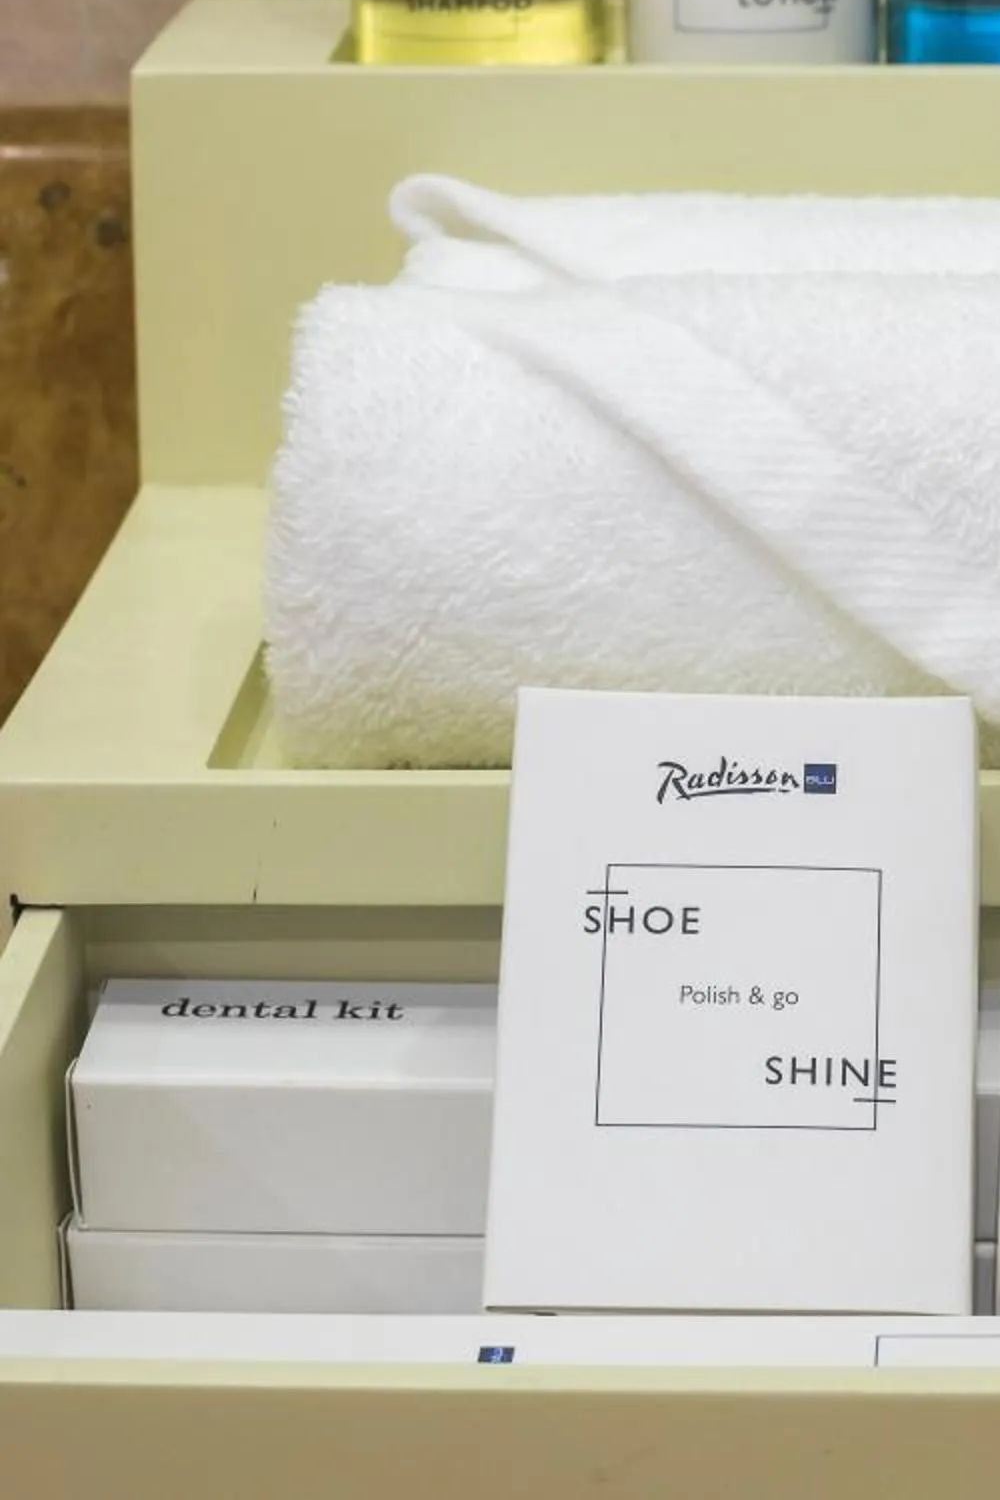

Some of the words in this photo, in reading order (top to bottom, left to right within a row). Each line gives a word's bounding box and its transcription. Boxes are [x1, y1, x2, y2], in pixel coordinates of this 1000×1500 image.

[656, 755, 801, 805] Radisson
[583, 906, 701, 935] SHOE
[160, 997, 319, 1021] dental
[331, 1000, 406, 1022] kit
[679, 985, 741, 1005] Polish
[748, 986, 766, 1006] &
[773, 988, 799, 1010] go
[764, 1056, 898, 1089] SHINE
